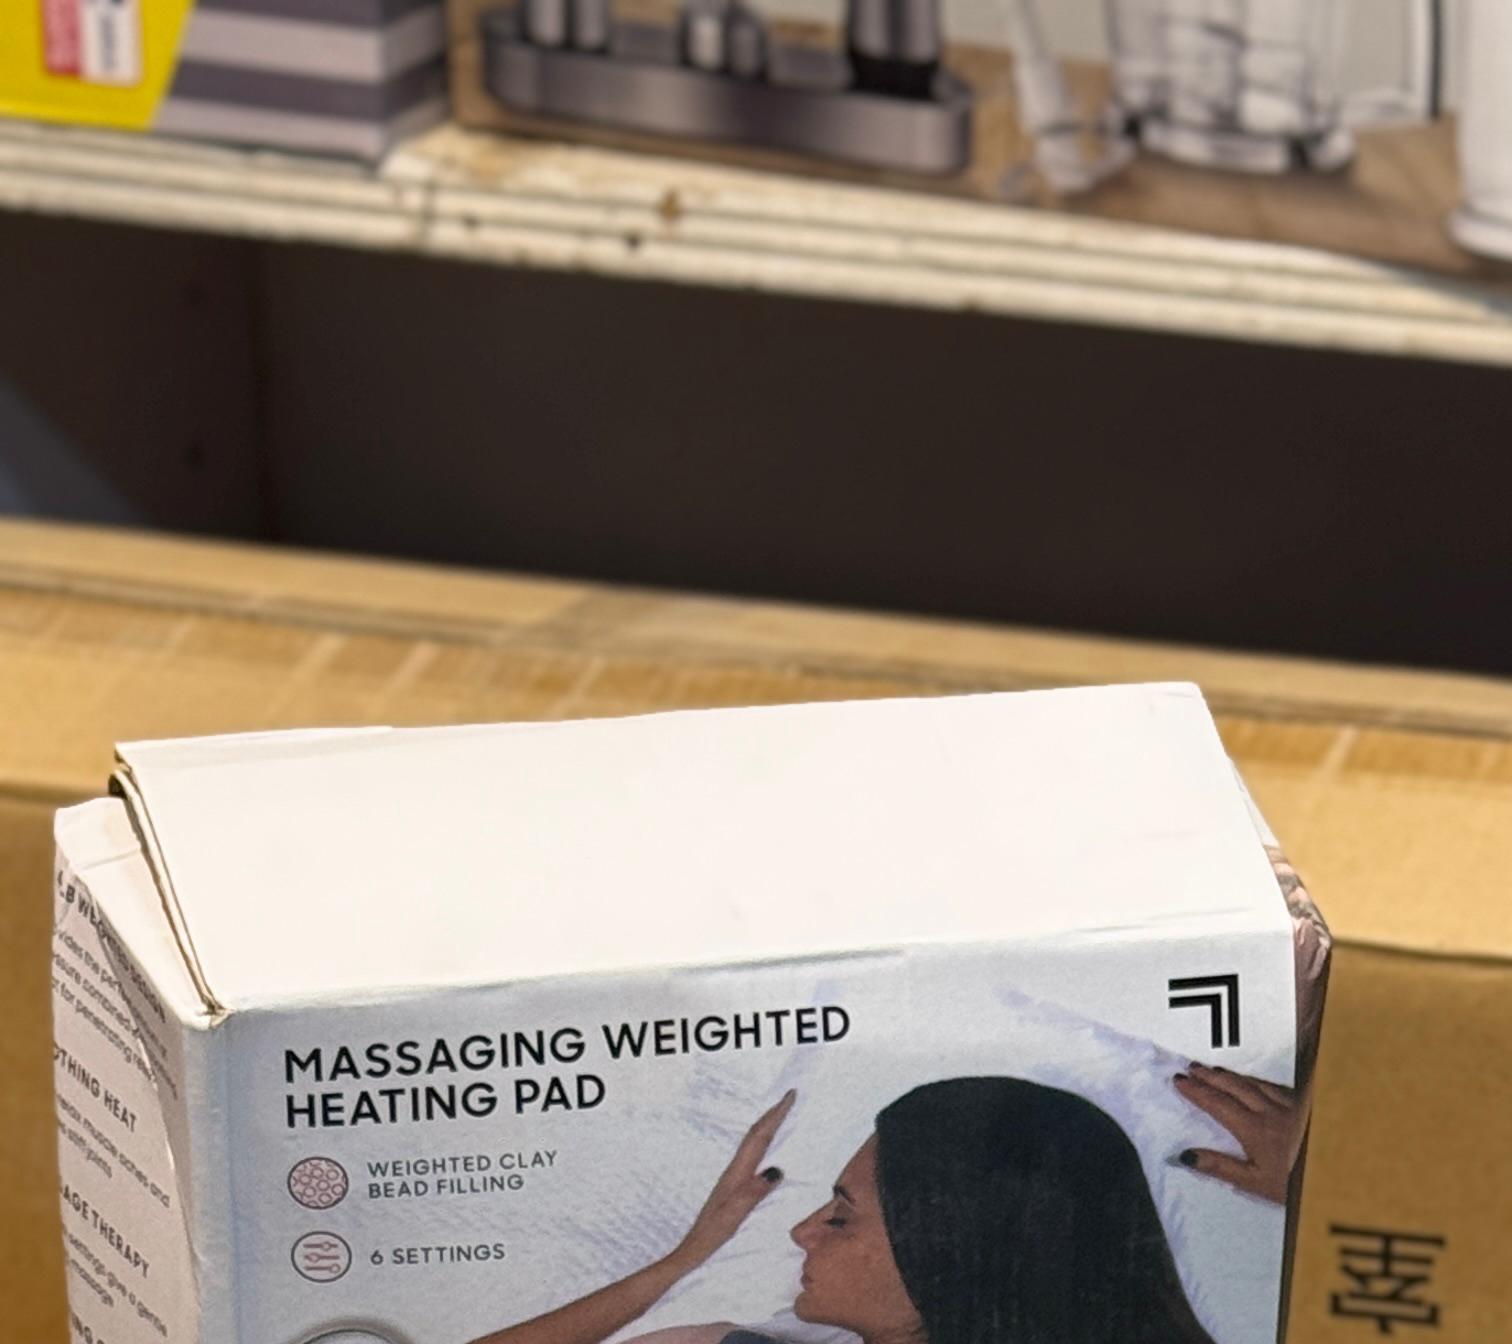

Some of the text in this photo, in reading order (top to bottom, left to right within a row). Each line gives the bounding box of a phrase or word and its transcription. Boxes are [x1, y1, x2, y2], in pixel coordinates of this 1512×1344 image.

[285, 1006, 850, 1083] MASSAGING WEIGHTED
[104, 1087, 135, 1136] HEAT
[286, 1074, 605, 1128] HEATING PAD
[367, 1150, 558, 1178] WEIGHTED CLAY
[368, 1174, 524, 1199] BEAD FILLING
[91, 1213, 151, 1279] THERAPY
[370, 1243, 506, 1265] 6 SETTINGS
[1329, 1223, 1448, 1335] 室
